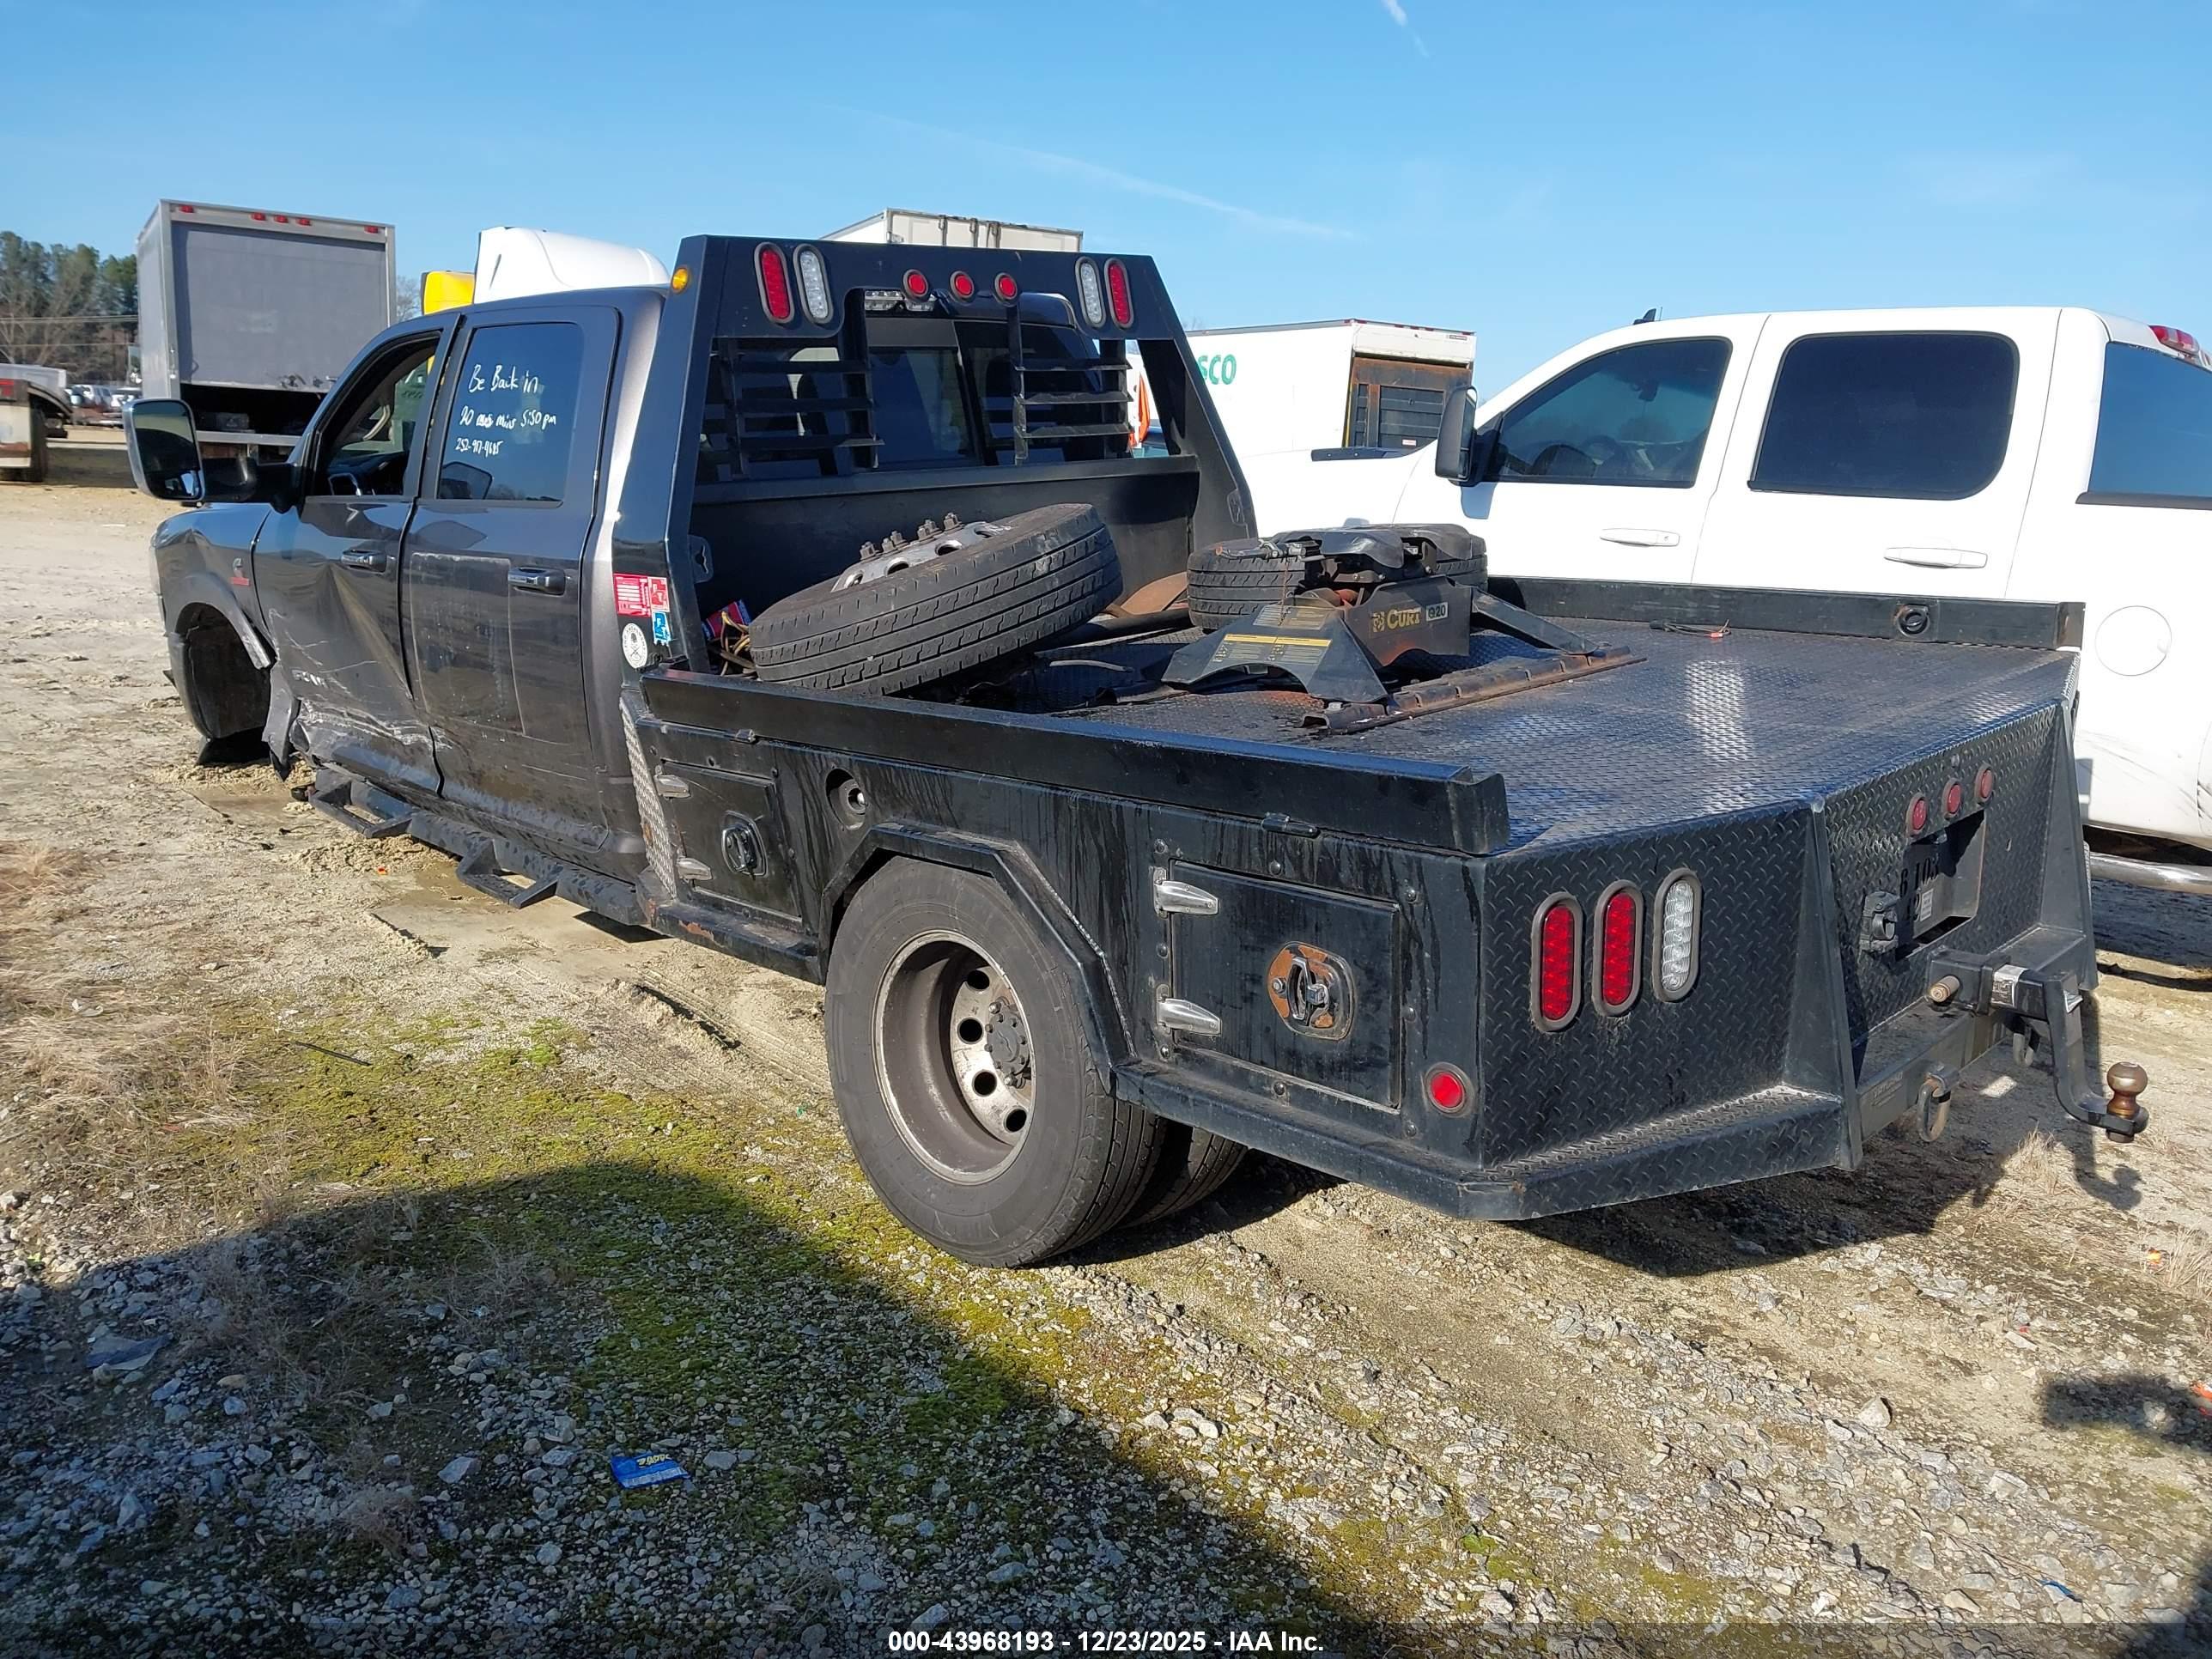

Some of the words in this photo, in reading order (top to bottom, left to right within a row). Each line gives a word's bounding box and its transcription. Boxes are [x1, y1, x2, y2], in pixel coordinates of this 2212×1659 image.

[468, 363, 485, 392] Be
[490, 365, 519, 392] Back
[523, 369, 538, 393] in
